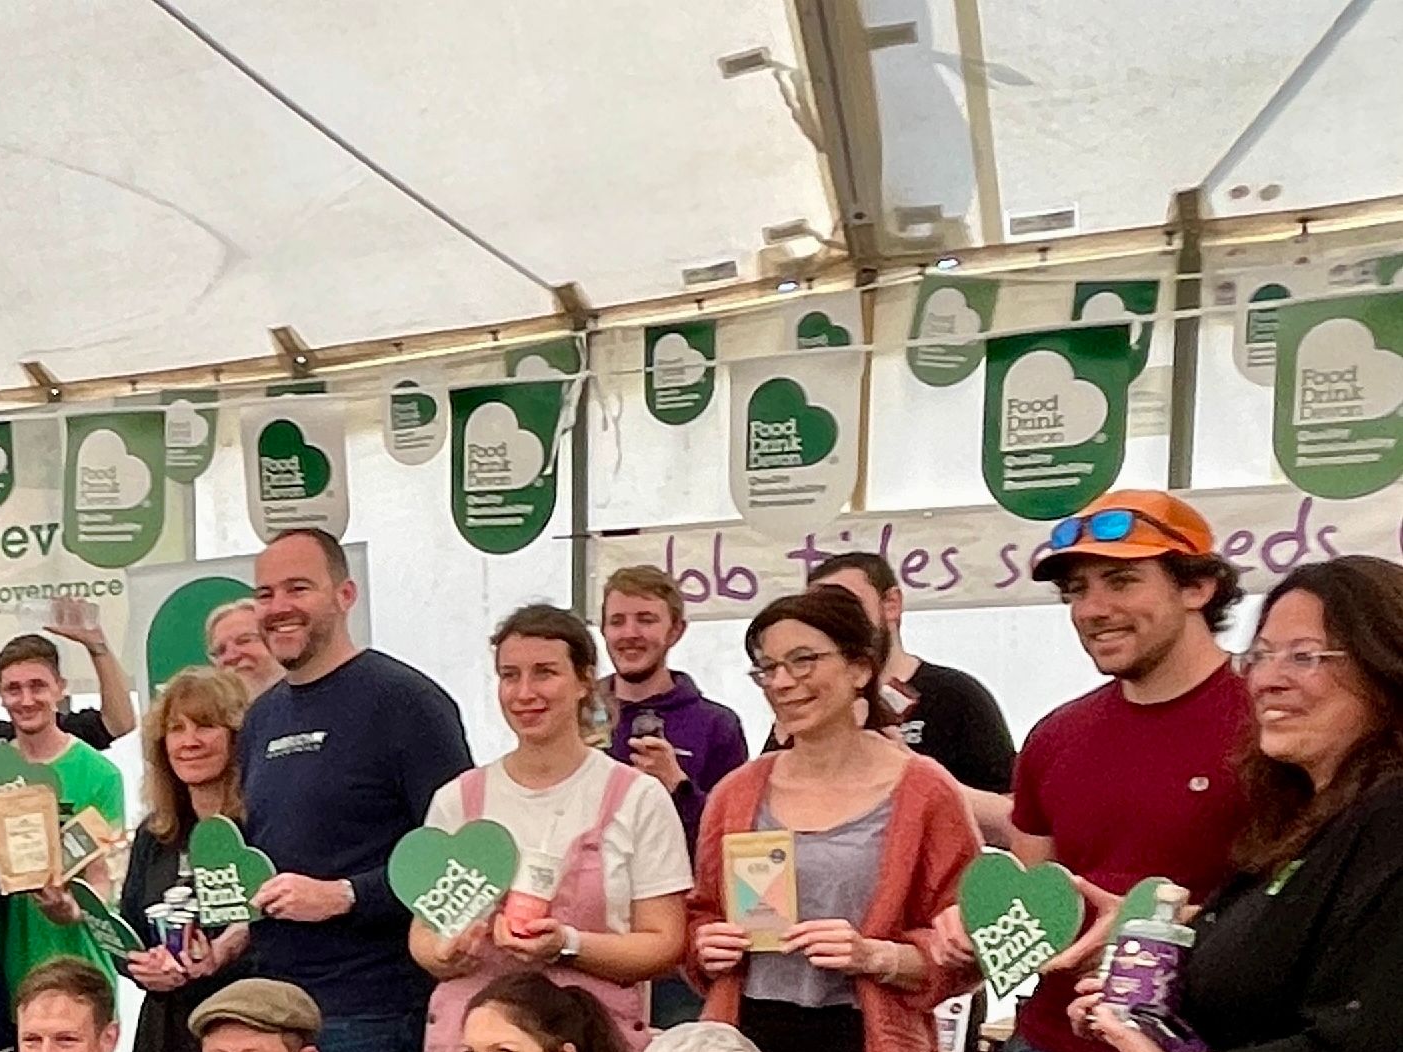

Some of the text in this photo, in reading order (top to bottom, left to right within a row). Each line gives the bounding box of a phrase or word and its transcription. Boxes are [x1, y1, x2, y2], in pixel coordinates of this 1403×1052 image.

[1301, 365, 1358, 386] Food
[1007, 394, 1059, 416] Food
[750, 418, 797, 439] Food
[1007, 412, 1064, 432] Drink
[193, 862, 240, 887] Food
[413, 858, 468, 913] Food
[196, 883, 247, 906] Drink
[429, 868, 487, 930] Drink
[200, 905, 251, 924] Devon
[971, 898, 1030, 953] Food
[982, 918, 1047, 976] Drink
[991, 941, 1056, 996] Devon
